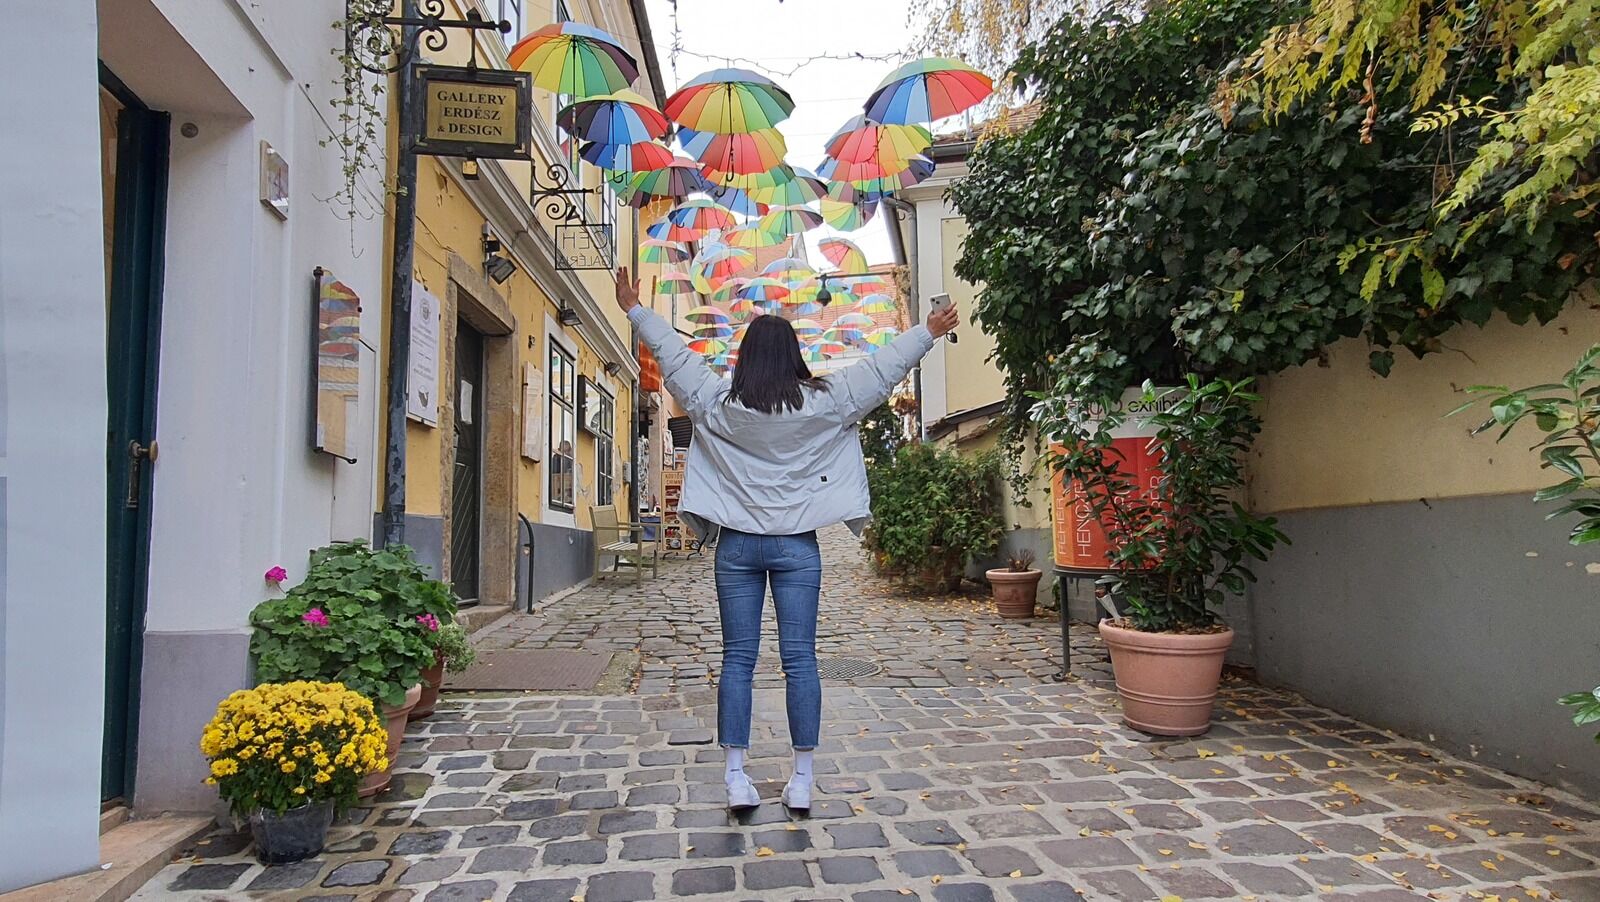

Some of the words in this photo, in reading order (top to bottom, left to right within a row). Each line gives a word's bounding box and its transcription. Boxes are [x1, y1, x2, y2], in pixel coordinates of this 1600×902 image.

[437, 90, 507, 105] GALLERY
[443, 106, 501, 121] ERDÉSZ
[437, 125, 446, 133] &
[448, 123, 503, 136] DESIGN
